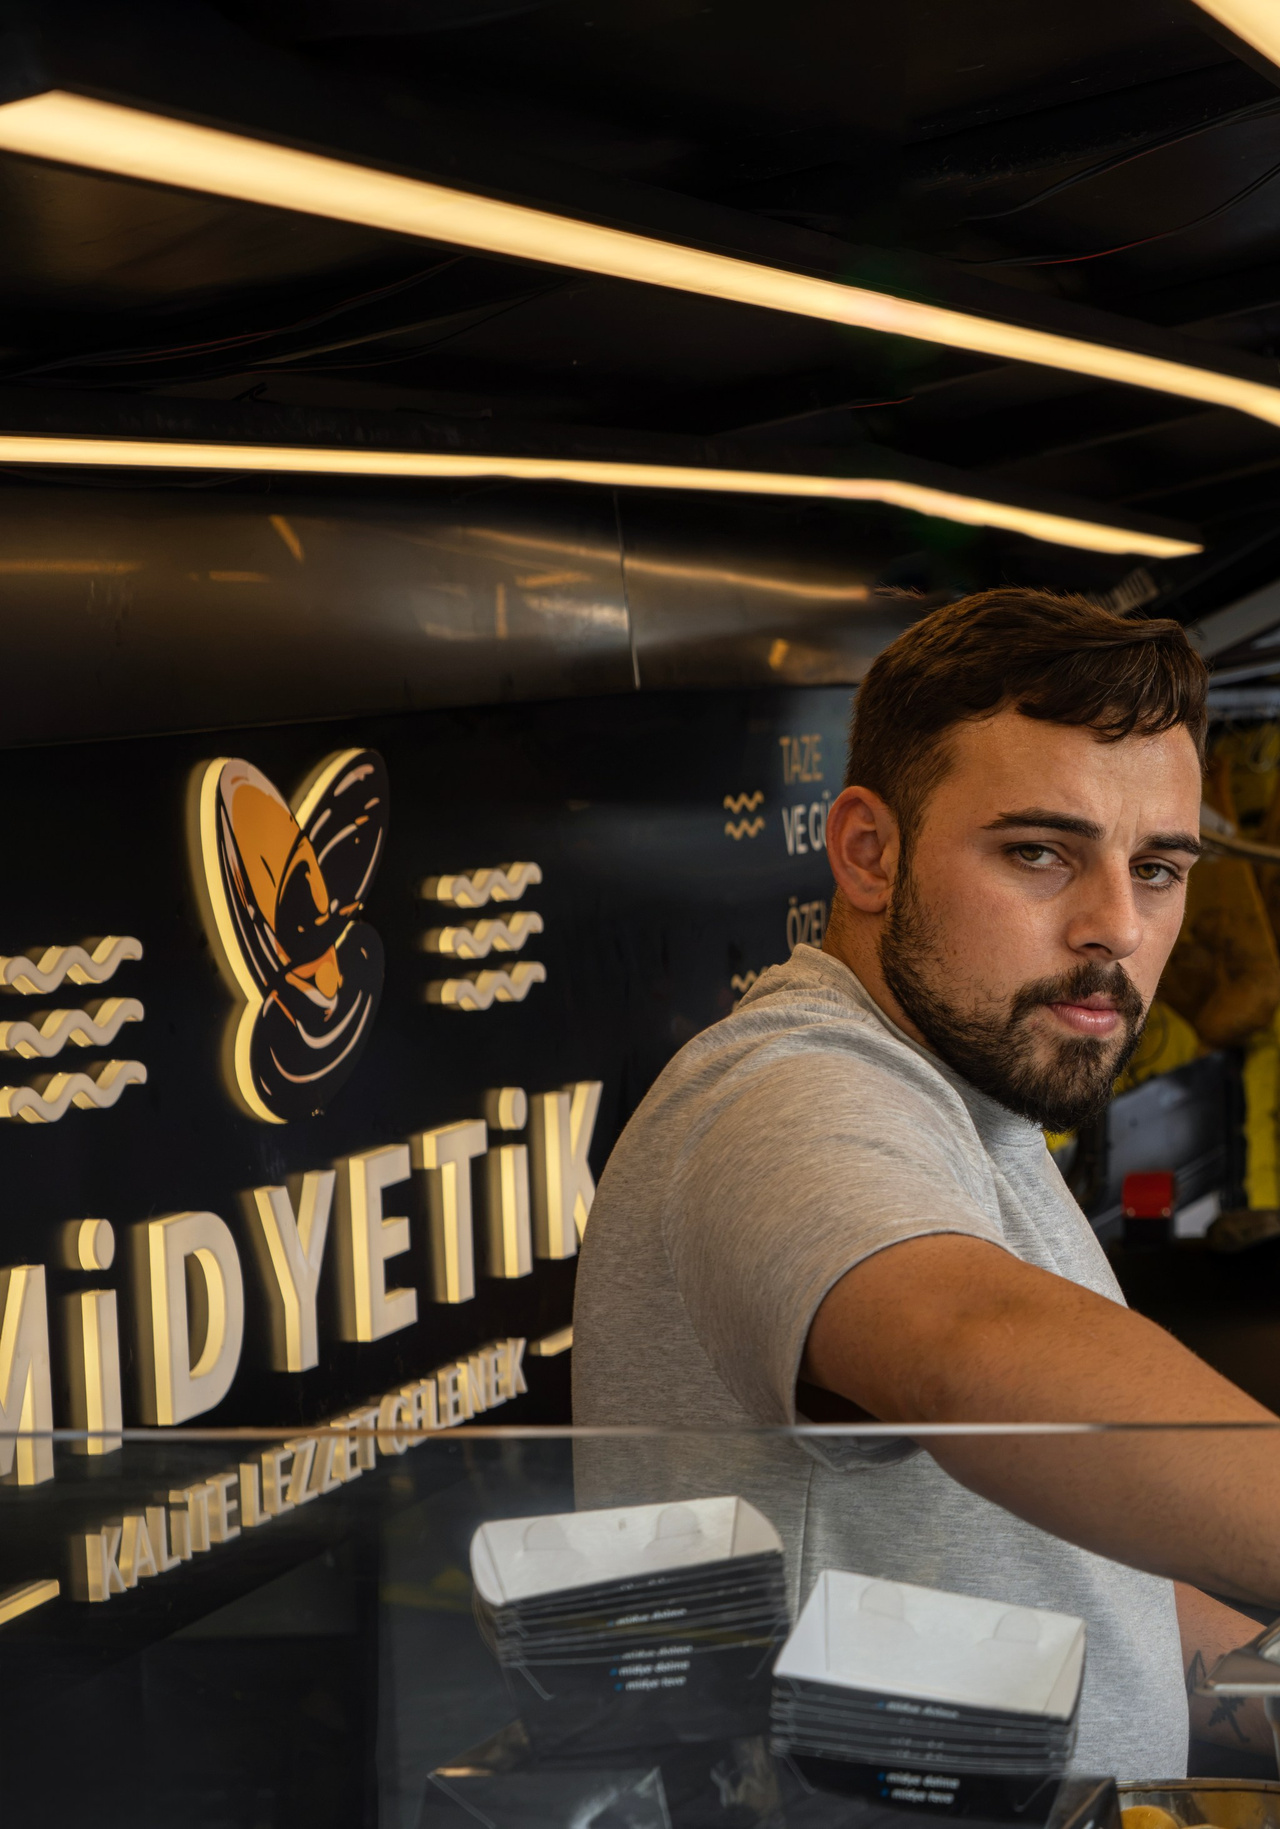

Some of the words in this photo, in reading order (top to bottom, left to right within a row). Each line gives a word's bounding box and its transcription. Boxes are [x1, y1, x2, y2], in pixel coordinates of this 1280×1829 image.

[779, 734, 823, 785] TAZE
[782, 804, 808, 857] VE
[239, 1407, 382, 1528] LEZZET
[377, 1337, 528, 1456] GELENEK
